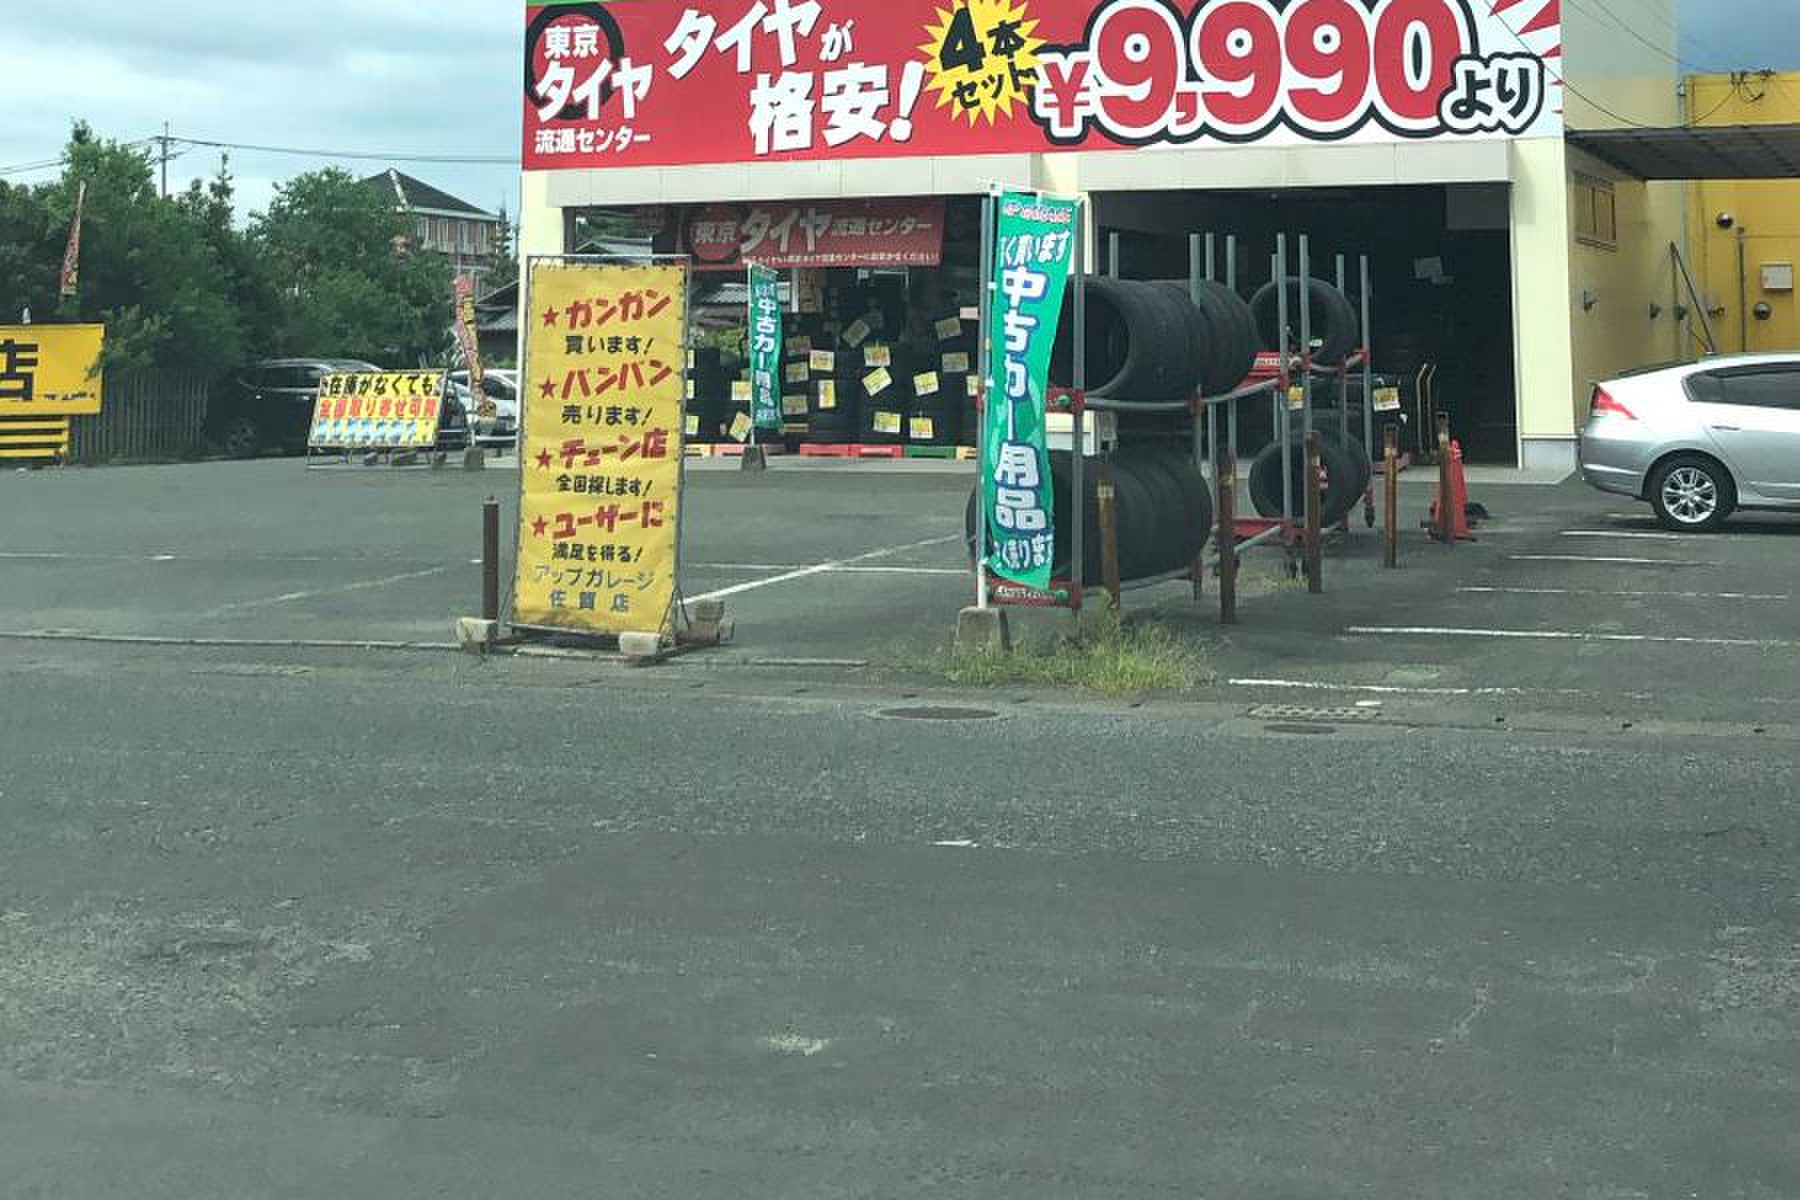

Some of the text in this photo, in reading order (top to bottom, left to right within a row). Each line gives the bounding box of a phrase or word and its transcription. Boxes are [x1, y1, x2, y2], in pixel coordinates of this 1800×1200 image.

[544, 24, 599, 58] 東京
[939, 6, 1026, 73] 4本
[535, 57, 653, 122] タイヤ
[951, 62, 1039, 109] セット
[748, 62, 927, 154] 格安!
[535, 125, 651, 154] 流通センター
[565, 289, 672, 330] ガンガン
[564, 336, 655, 356] 買います!
[561, 405, 653, 426] 売ります!
[559, 427, 669, 469] チェーン店
[553, 501, 664, 539] ユーザーに
[534, 564, 654, 590] アップガレージ
